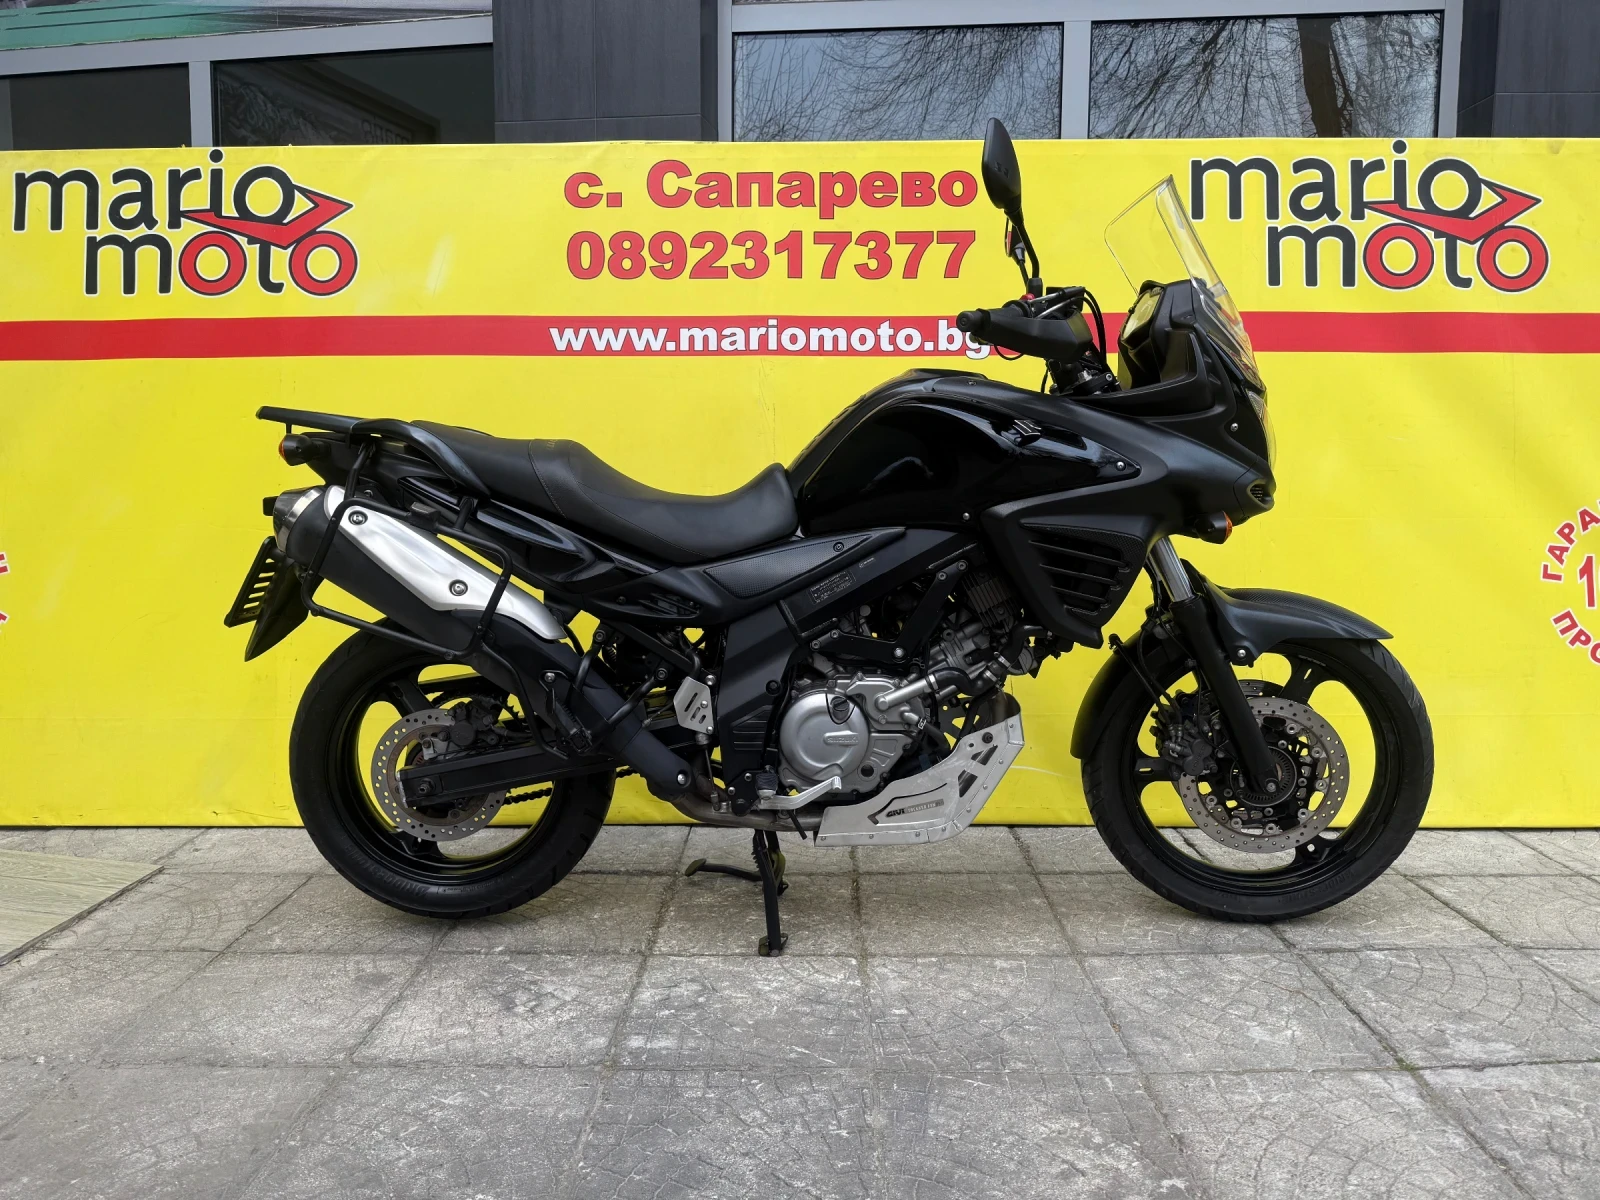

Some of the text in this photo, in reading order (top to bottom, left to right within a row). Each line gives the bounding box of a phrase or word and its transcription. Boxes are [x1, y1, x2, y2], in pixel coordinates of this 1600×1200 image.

[13, 148, 296, 232] mario
[563, 159, 978, 220] с. Сапарево
[1190, 139, 1482, 222] mario
[84, 230, 358, 296] moto
[566, 230, 977, 280] 0892317377
[1266, 223, 1549, 292] moto
[549, 318, 991, 360] www.mariomoto.bg
[1542, 500, 1600, 582] ГАРА
[886, 808, 905, 818] GIVI
